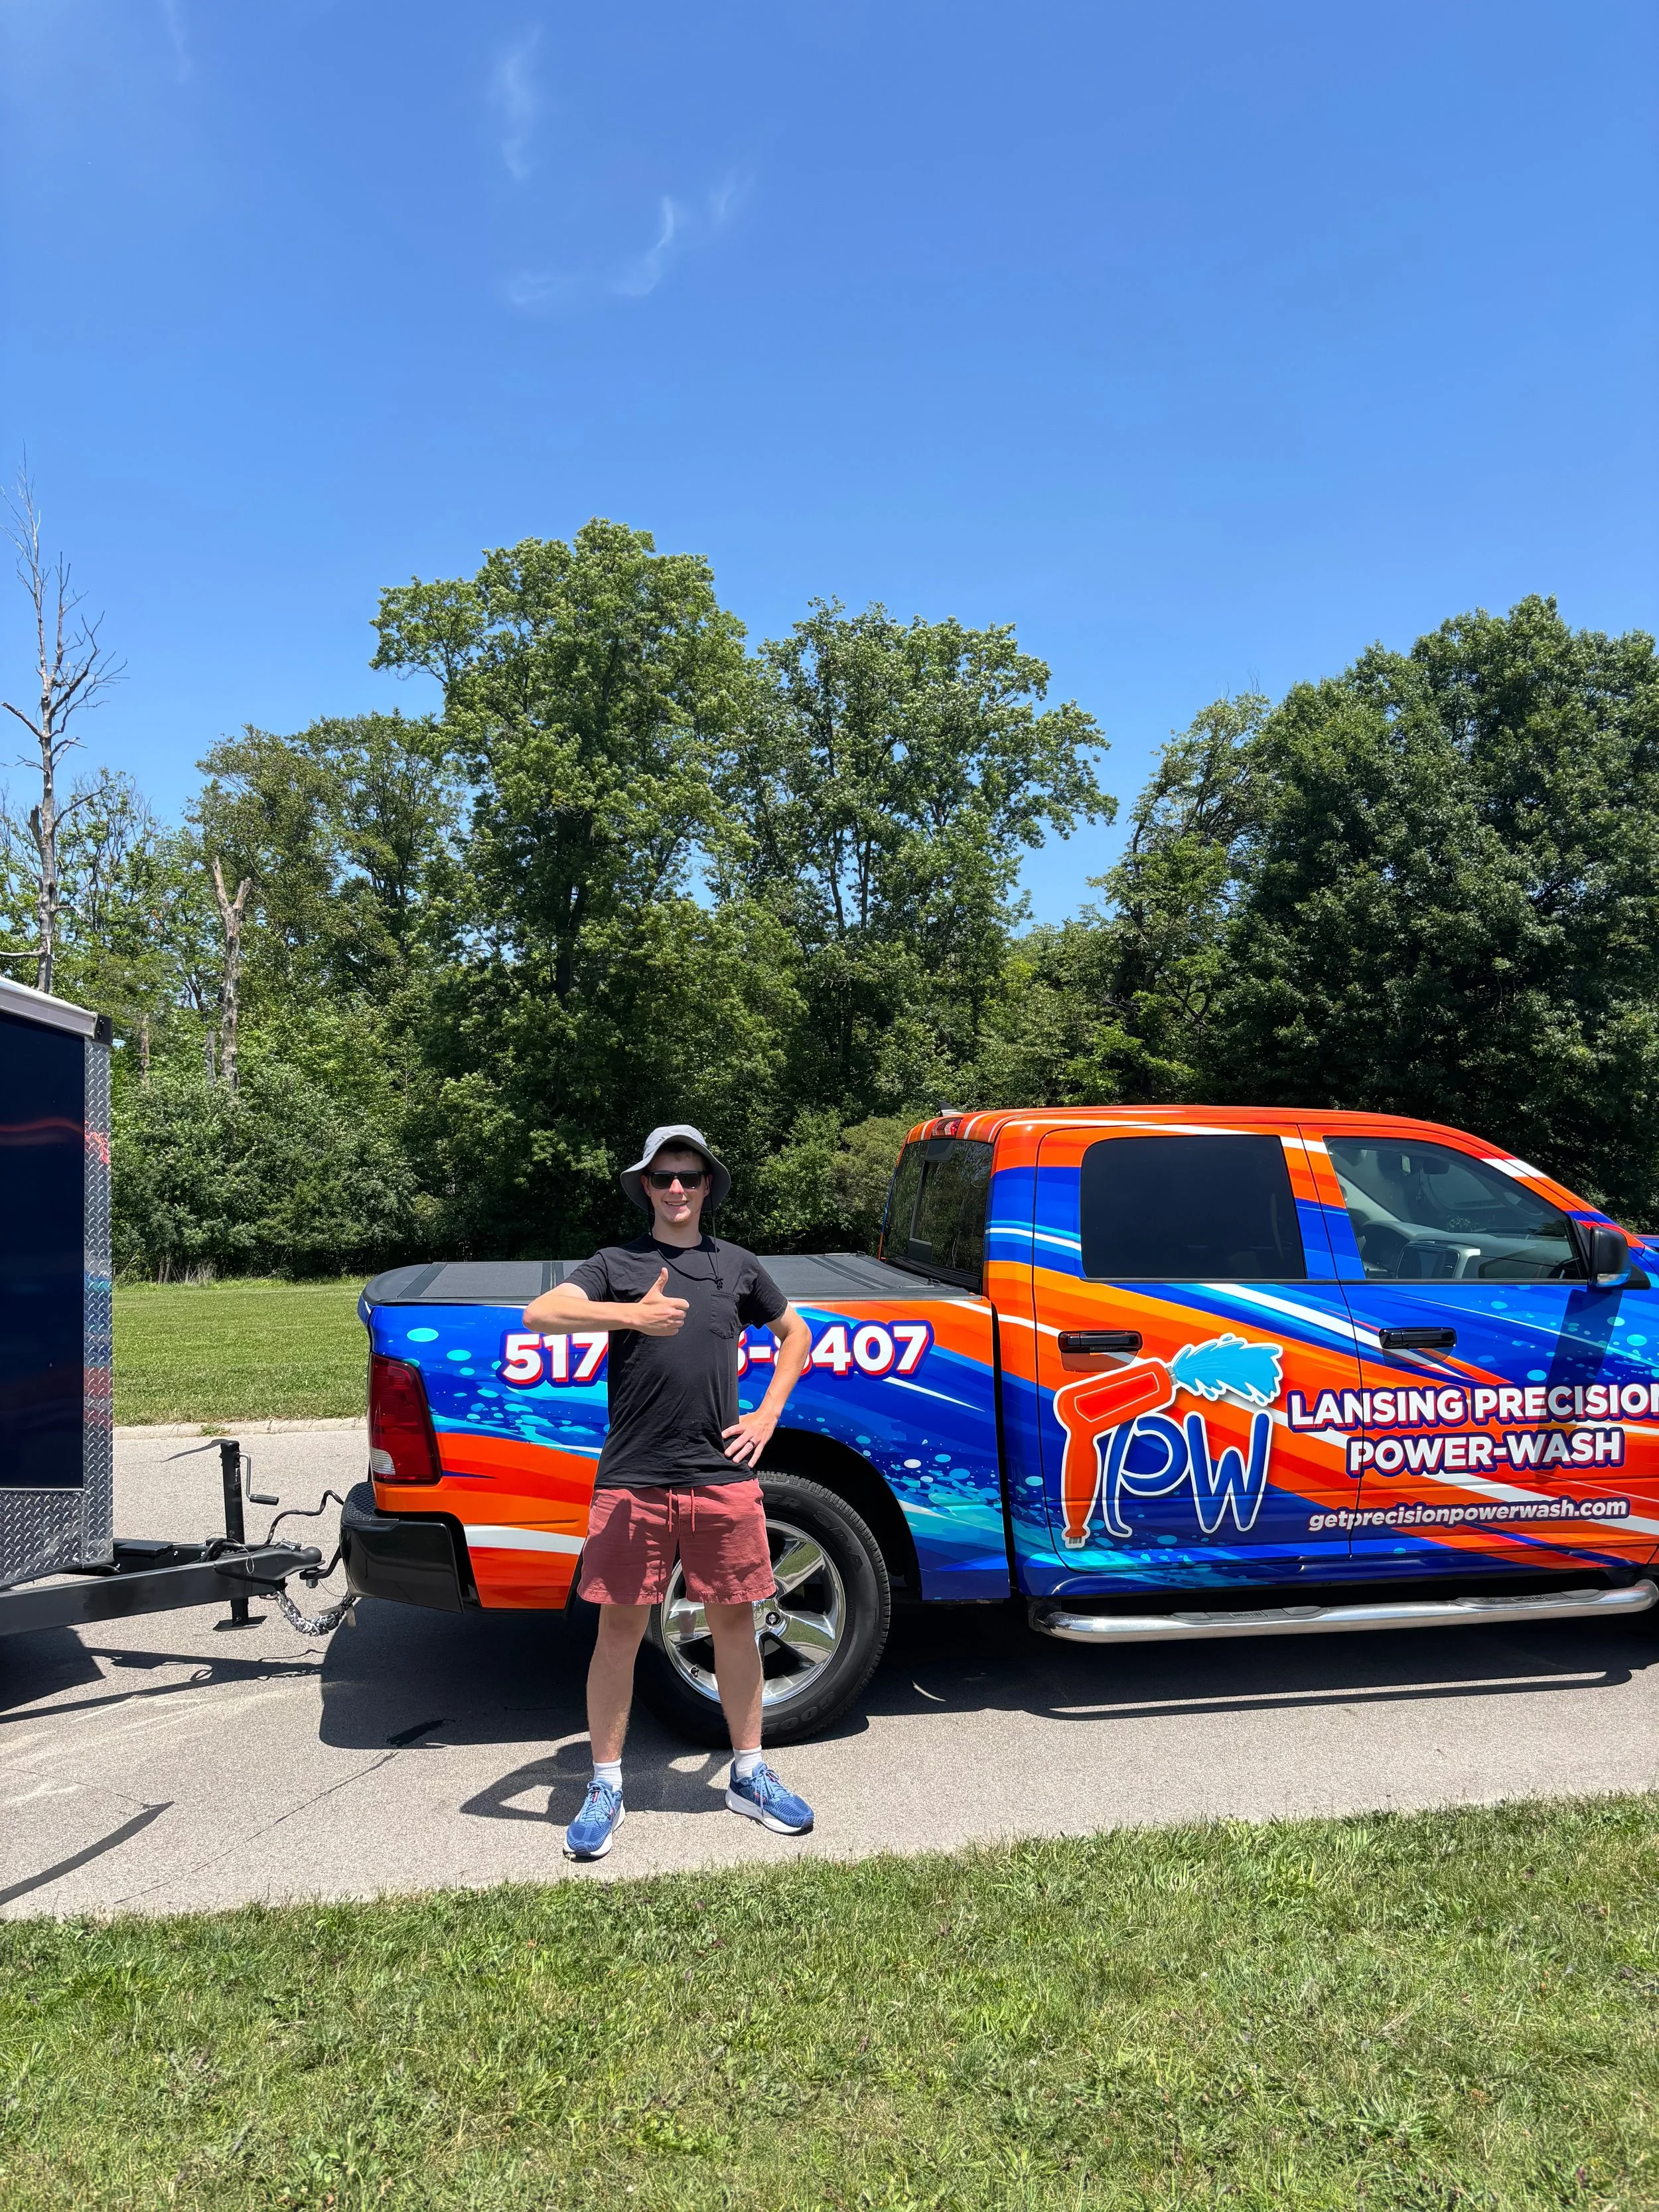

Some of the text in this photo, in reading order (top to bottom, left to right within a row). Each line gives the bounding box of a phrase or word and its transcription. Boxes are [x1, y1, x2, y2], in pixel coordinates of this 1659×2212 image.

[1291, 1388, 1466, 1428] LANSING
[1350, 1431, 1621, 1475] POWER-WASH
[1308, 1499, 1626, 1532] getprecisionpowerwash.com
